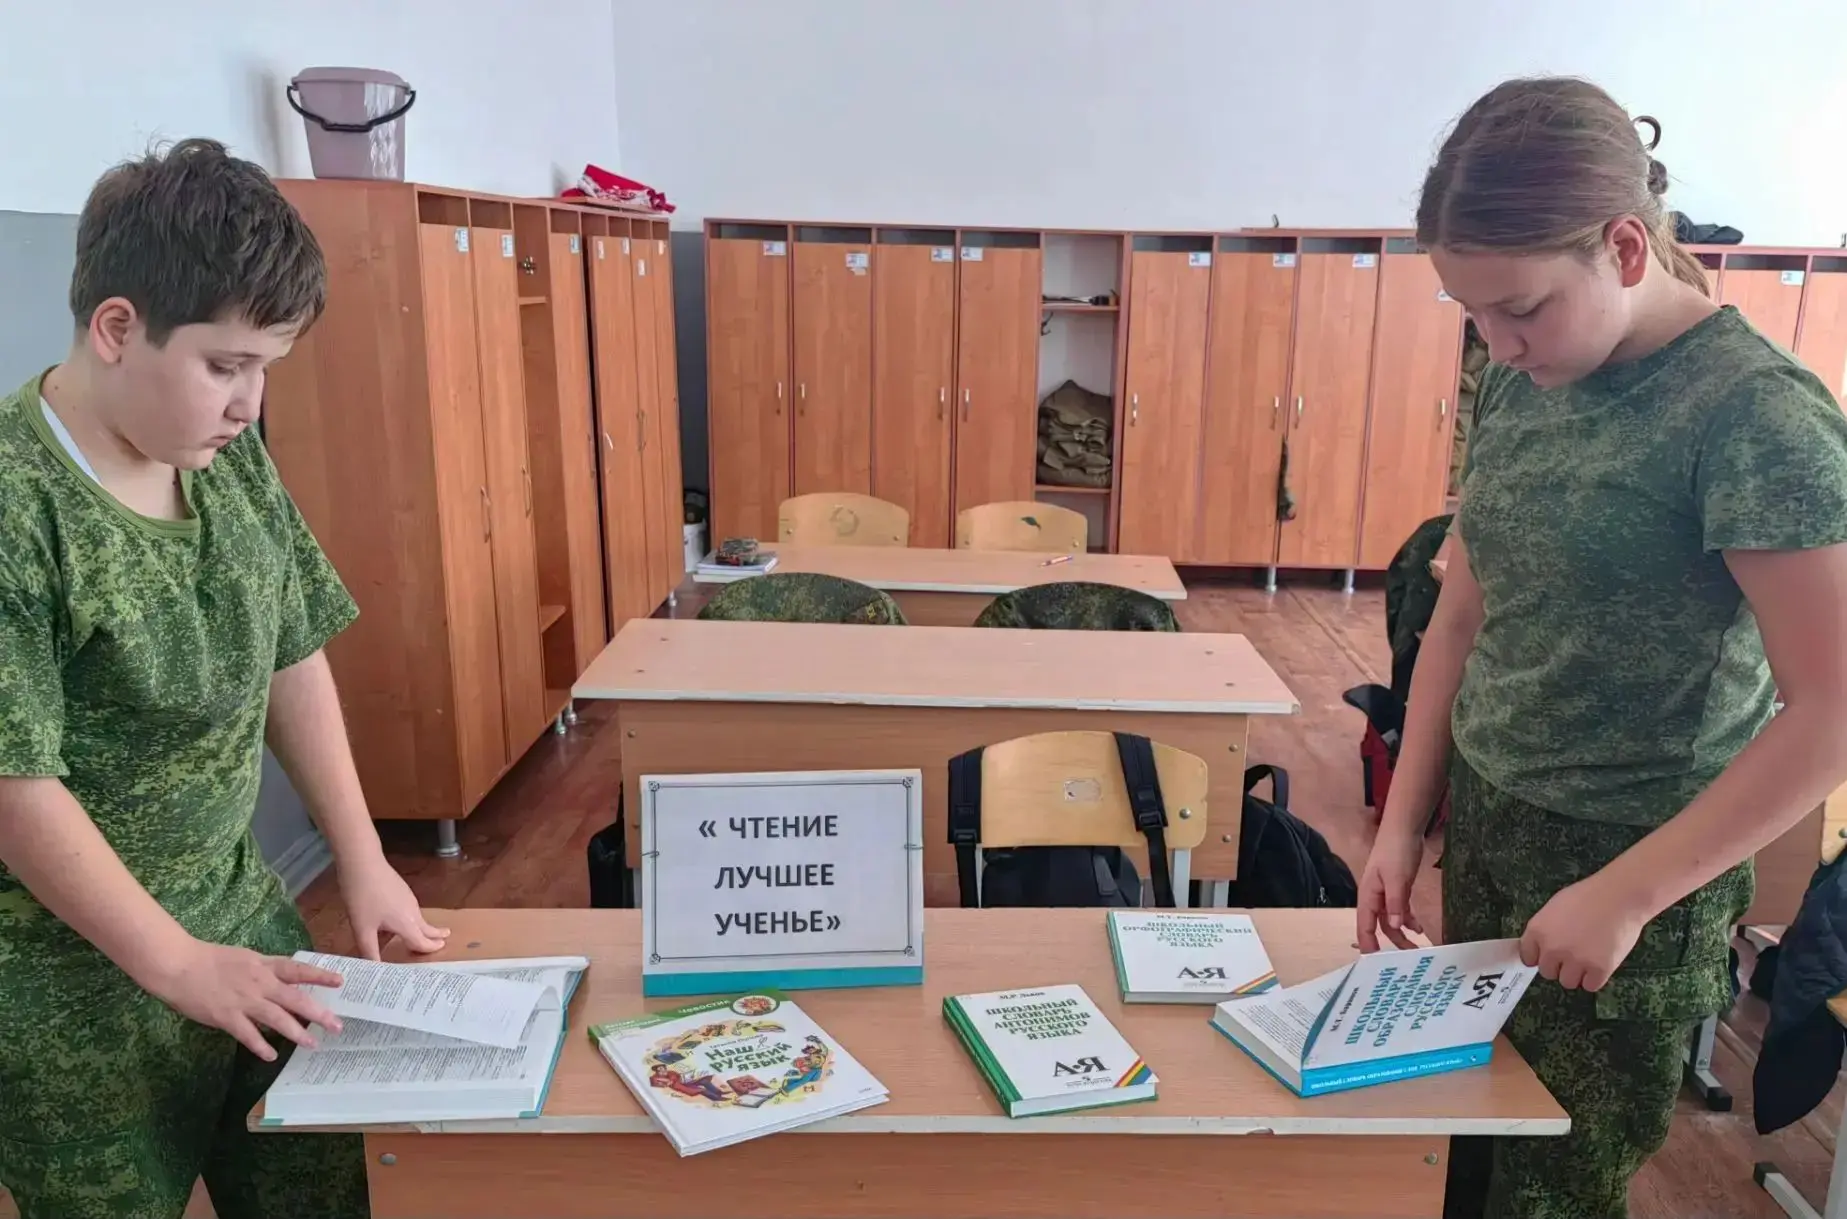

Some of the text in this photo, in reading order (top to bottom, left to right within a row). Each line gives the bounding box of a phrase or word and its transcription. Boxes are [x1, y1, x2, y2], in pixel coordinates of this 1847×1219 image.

[729, 815, 839, 839] ЧТЕНИЕ
[714, 864, 835, 889] ЛУЧШЕЕ
[714, 910, 841, 936] УЧЕНЬЕ»
[985, 998, 1078, 1015] ШКОЛЬНЫЙ
[1345, 966, 1398, 1045] ШКОЛЬНЫЙ
[1366, 974, 1408, 1033] СЛОВАРЬ
[1373, 955, 1435, 1047] ОБРАЗОВАНИЯ
[1404, 983, 1432, 1017] СЛОВ
[1410, 965, 1457, 1030] РУССКОГО
[1431, 974, 1467, 1017] ЯЗЫКА
[994, 1012, 1091, 1029] АНТОНИМОВ
[1002, 1007, 1072, 1021] СЛОВАРЬ
[1009, 1020, 1088, 1035] РУССКОГО
[1027, 1028, 1082, 1040] ЯЗЫКА
[705, 1045, 754, 1060] Наш
[709, 1042, 792, 1073] русский
[737, 1055, 791, 1071] язык
